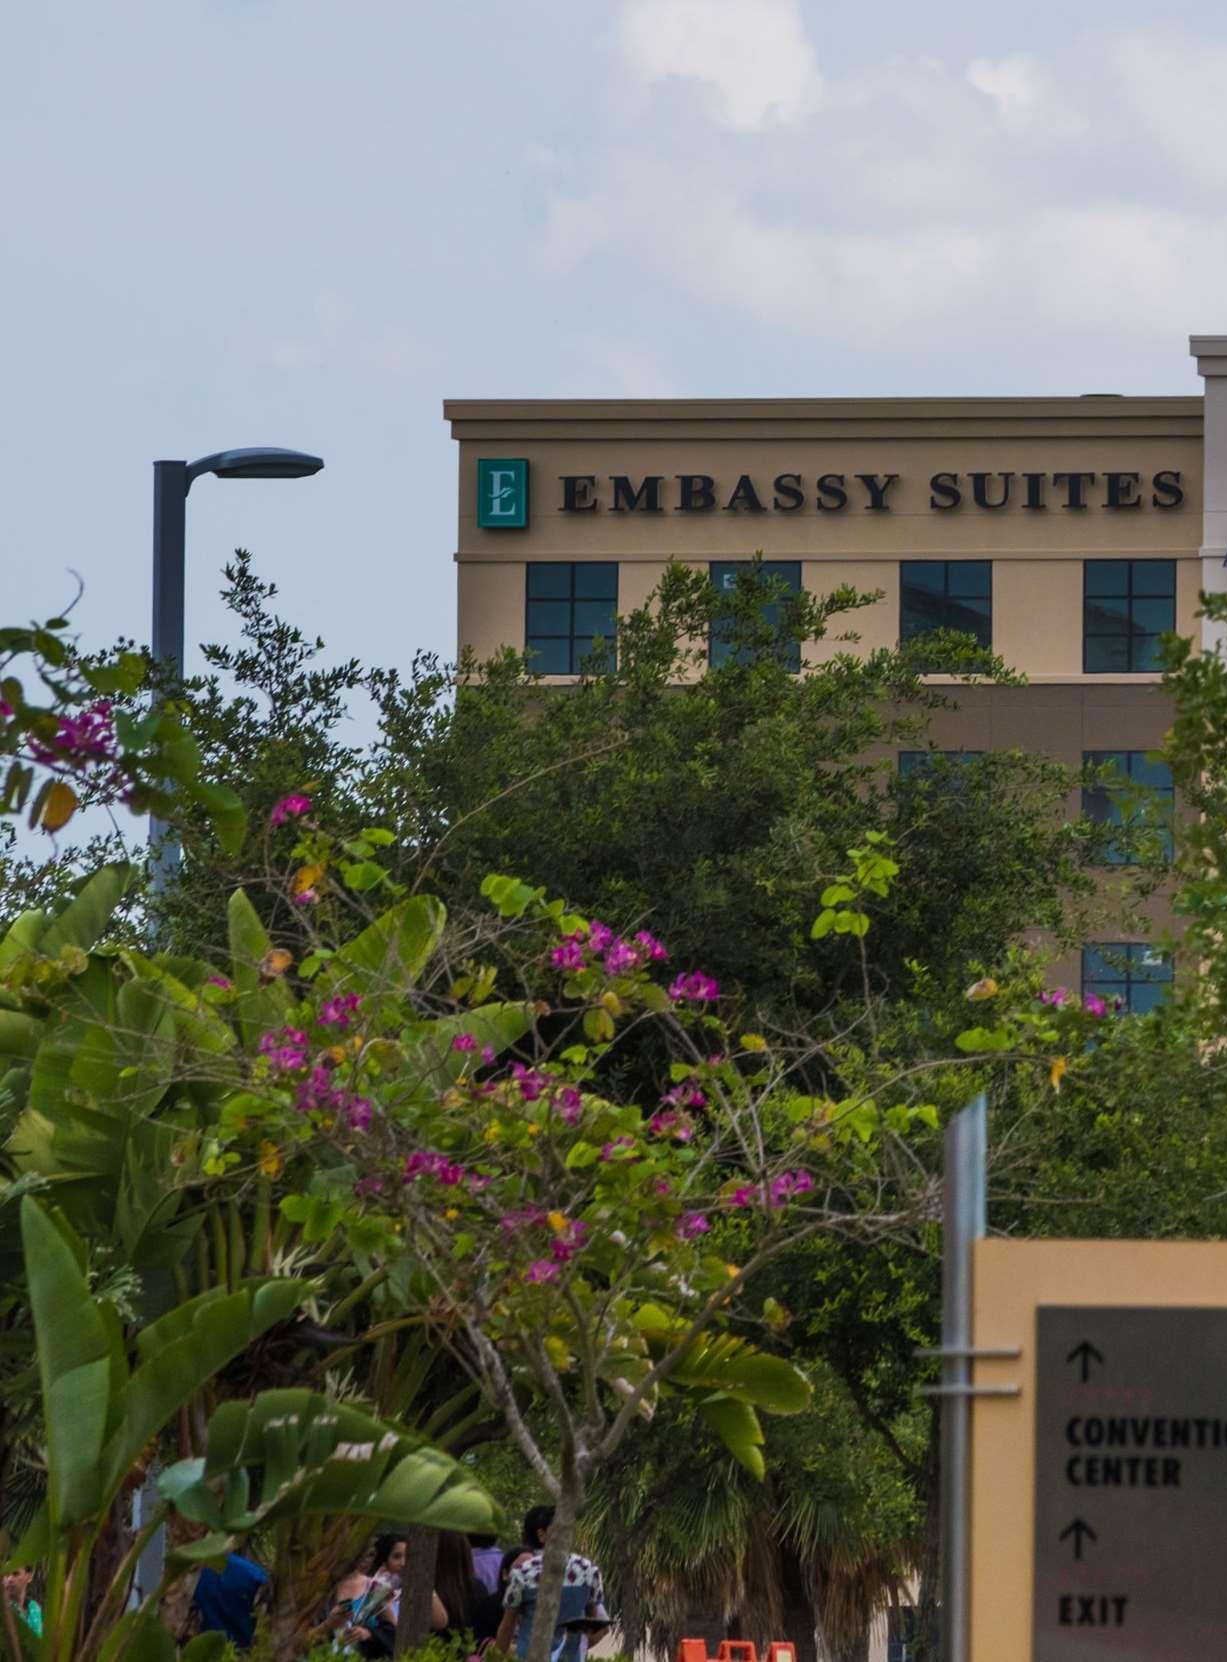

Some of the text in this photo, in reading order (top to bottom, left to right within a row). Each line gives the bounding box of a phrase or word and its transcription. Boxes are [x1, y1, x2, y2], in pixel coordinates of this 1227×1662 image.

[557, 470, 1185, 512] EMBASSY SUITES
[1064, 1456, 1182, 1488] CENTER
[1057, 1594, 1129, 1627] EXIT
